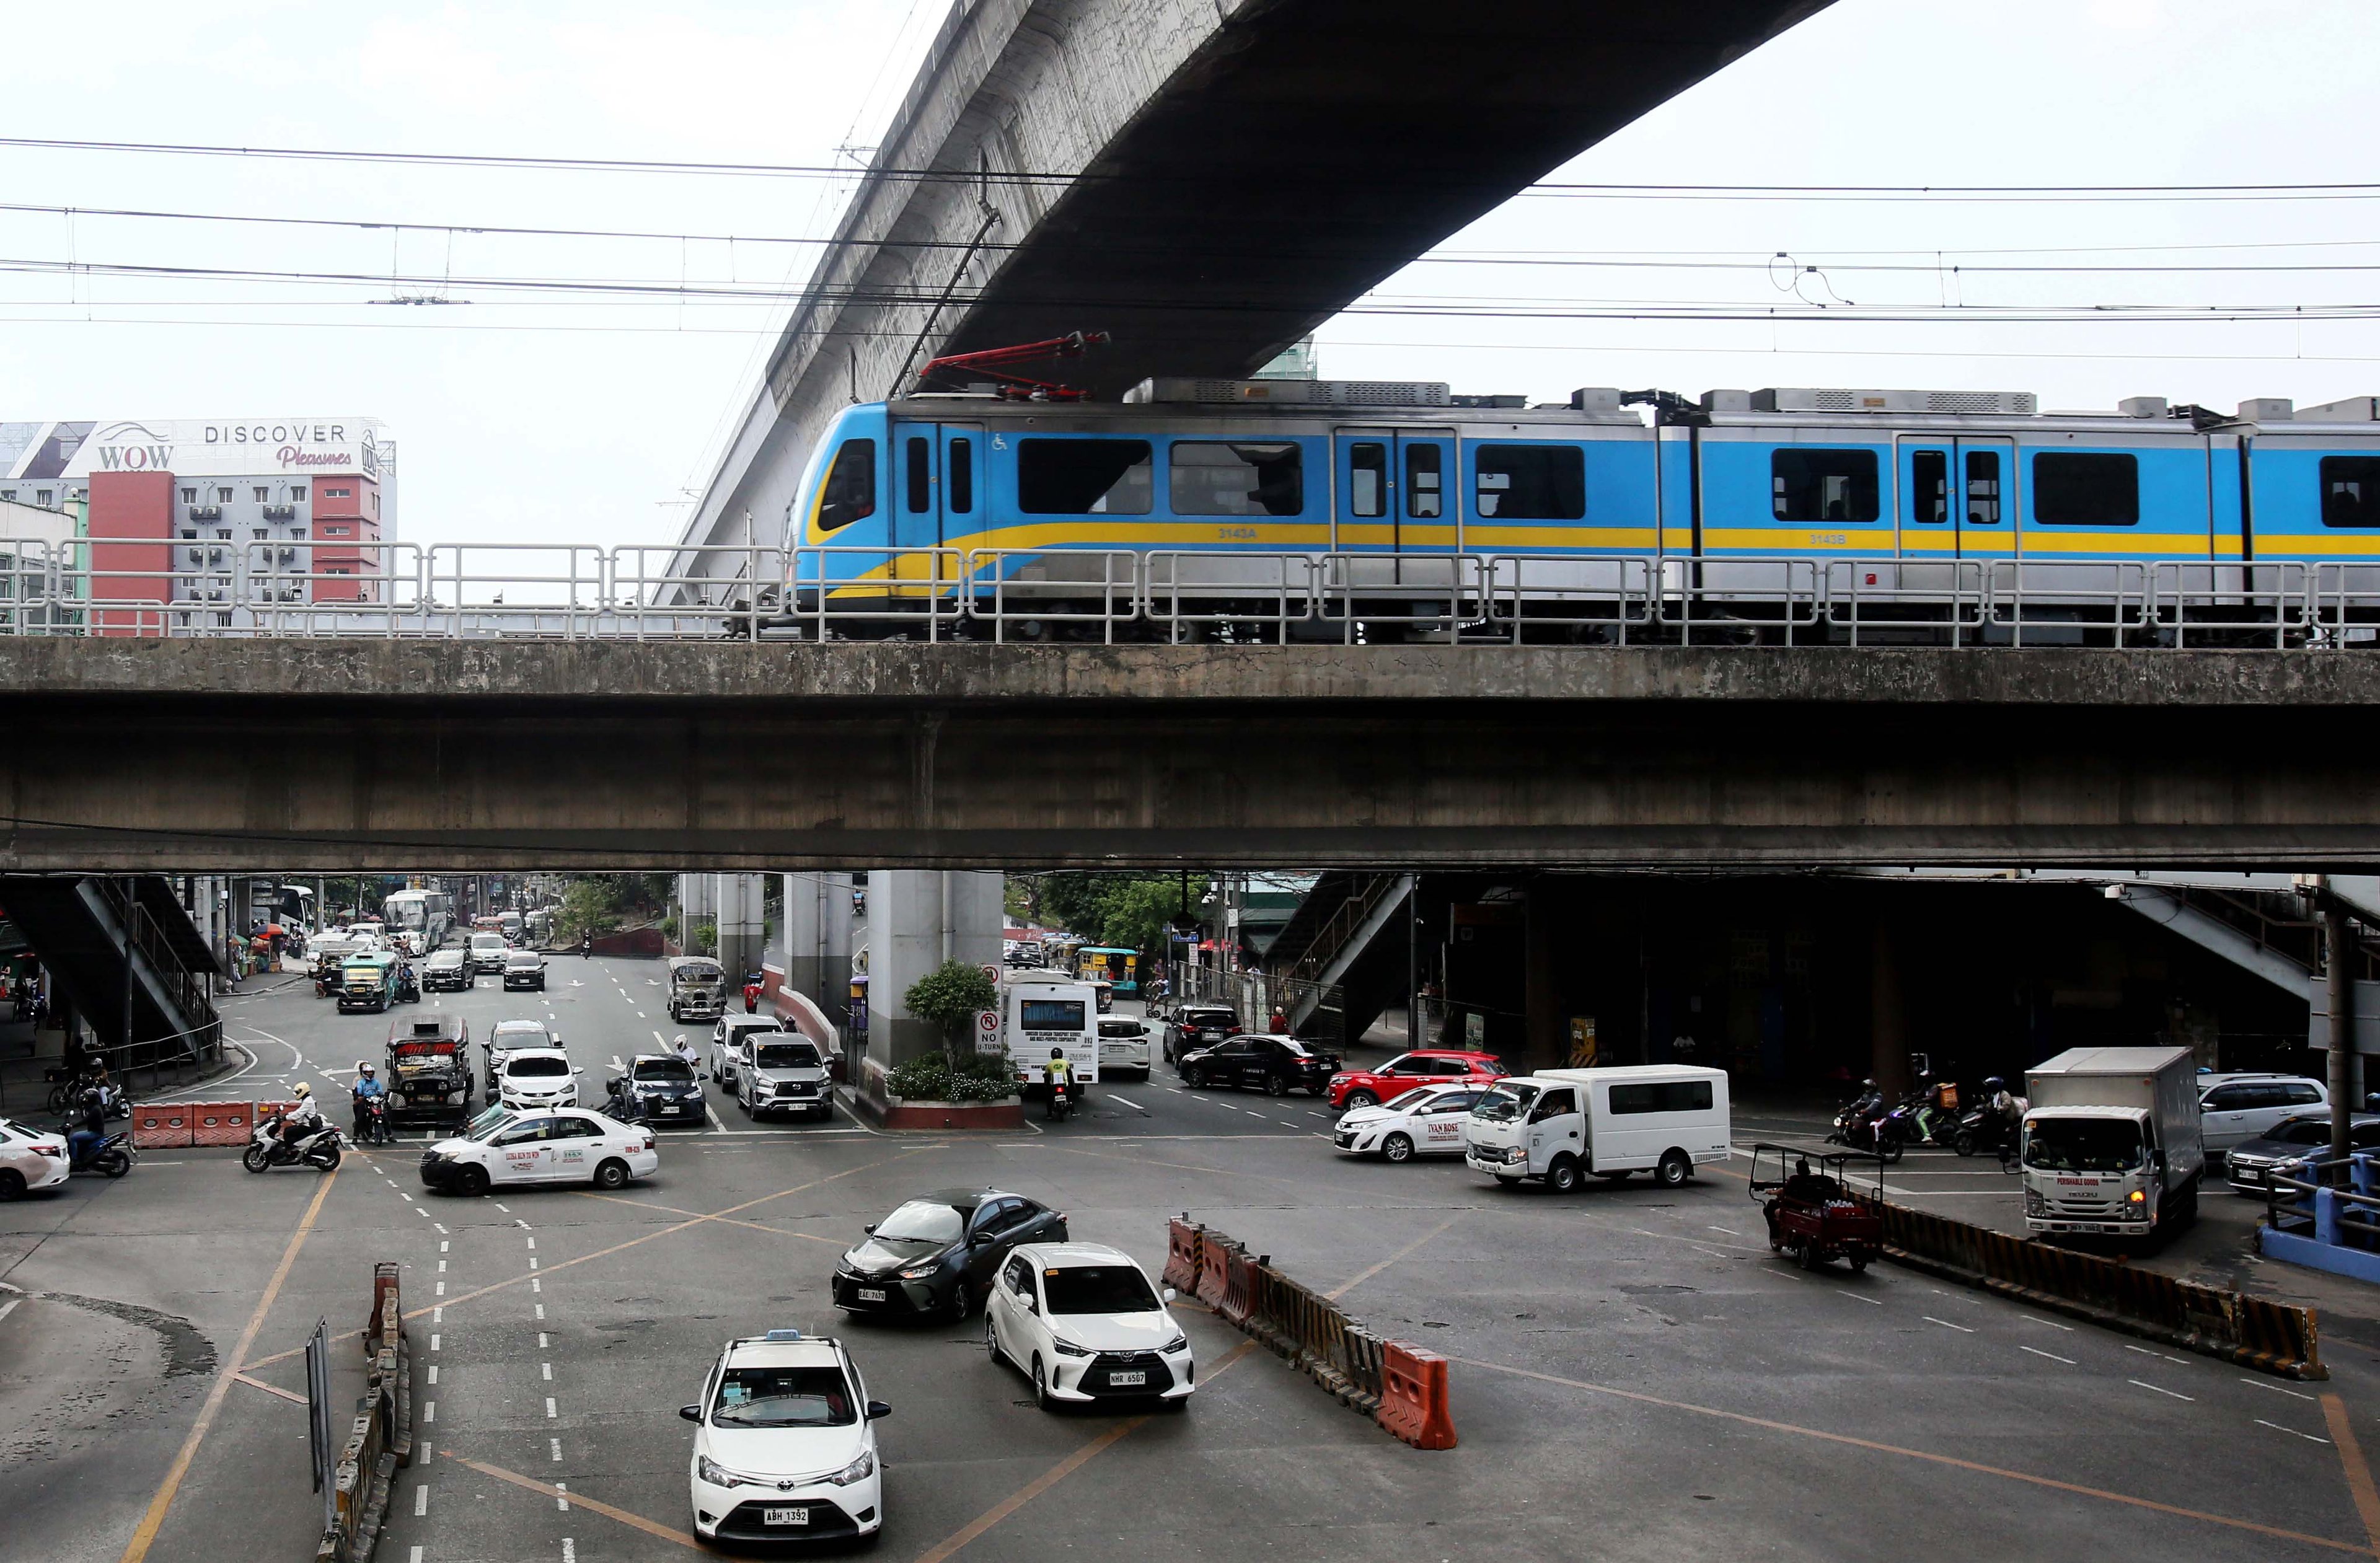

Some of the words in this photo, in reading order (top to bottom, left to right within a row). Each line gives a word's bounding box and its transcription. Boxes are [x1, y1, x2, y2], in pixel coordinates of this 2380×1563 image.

[205, 425, 345, 443] DISCOVER
[98, 446, 174, 469] WOW
[276, 445, 351, 469] Pleasures
[1219, 527, 1257, 539] 3143A
[1810, 534, 1845, 544] 3143B
[982, 1034, 996, 1042] NO
[1428, 1124, 1442, 1133] IVAN
[1443, 1123, 1459, 1132] ROSE
[2084, 1178, 2099, 1186] GOODS
[859, 1290, 869, 1298] EAE
[871, 1292, 884, 1300] 7670
[1111, 1375, 1124, 1383] NHR
[1128, 1374, 1144, 1383] 6507
[767, 1512, 782, 1521] ABH
[787, 1512, 806, 1521] 1392
